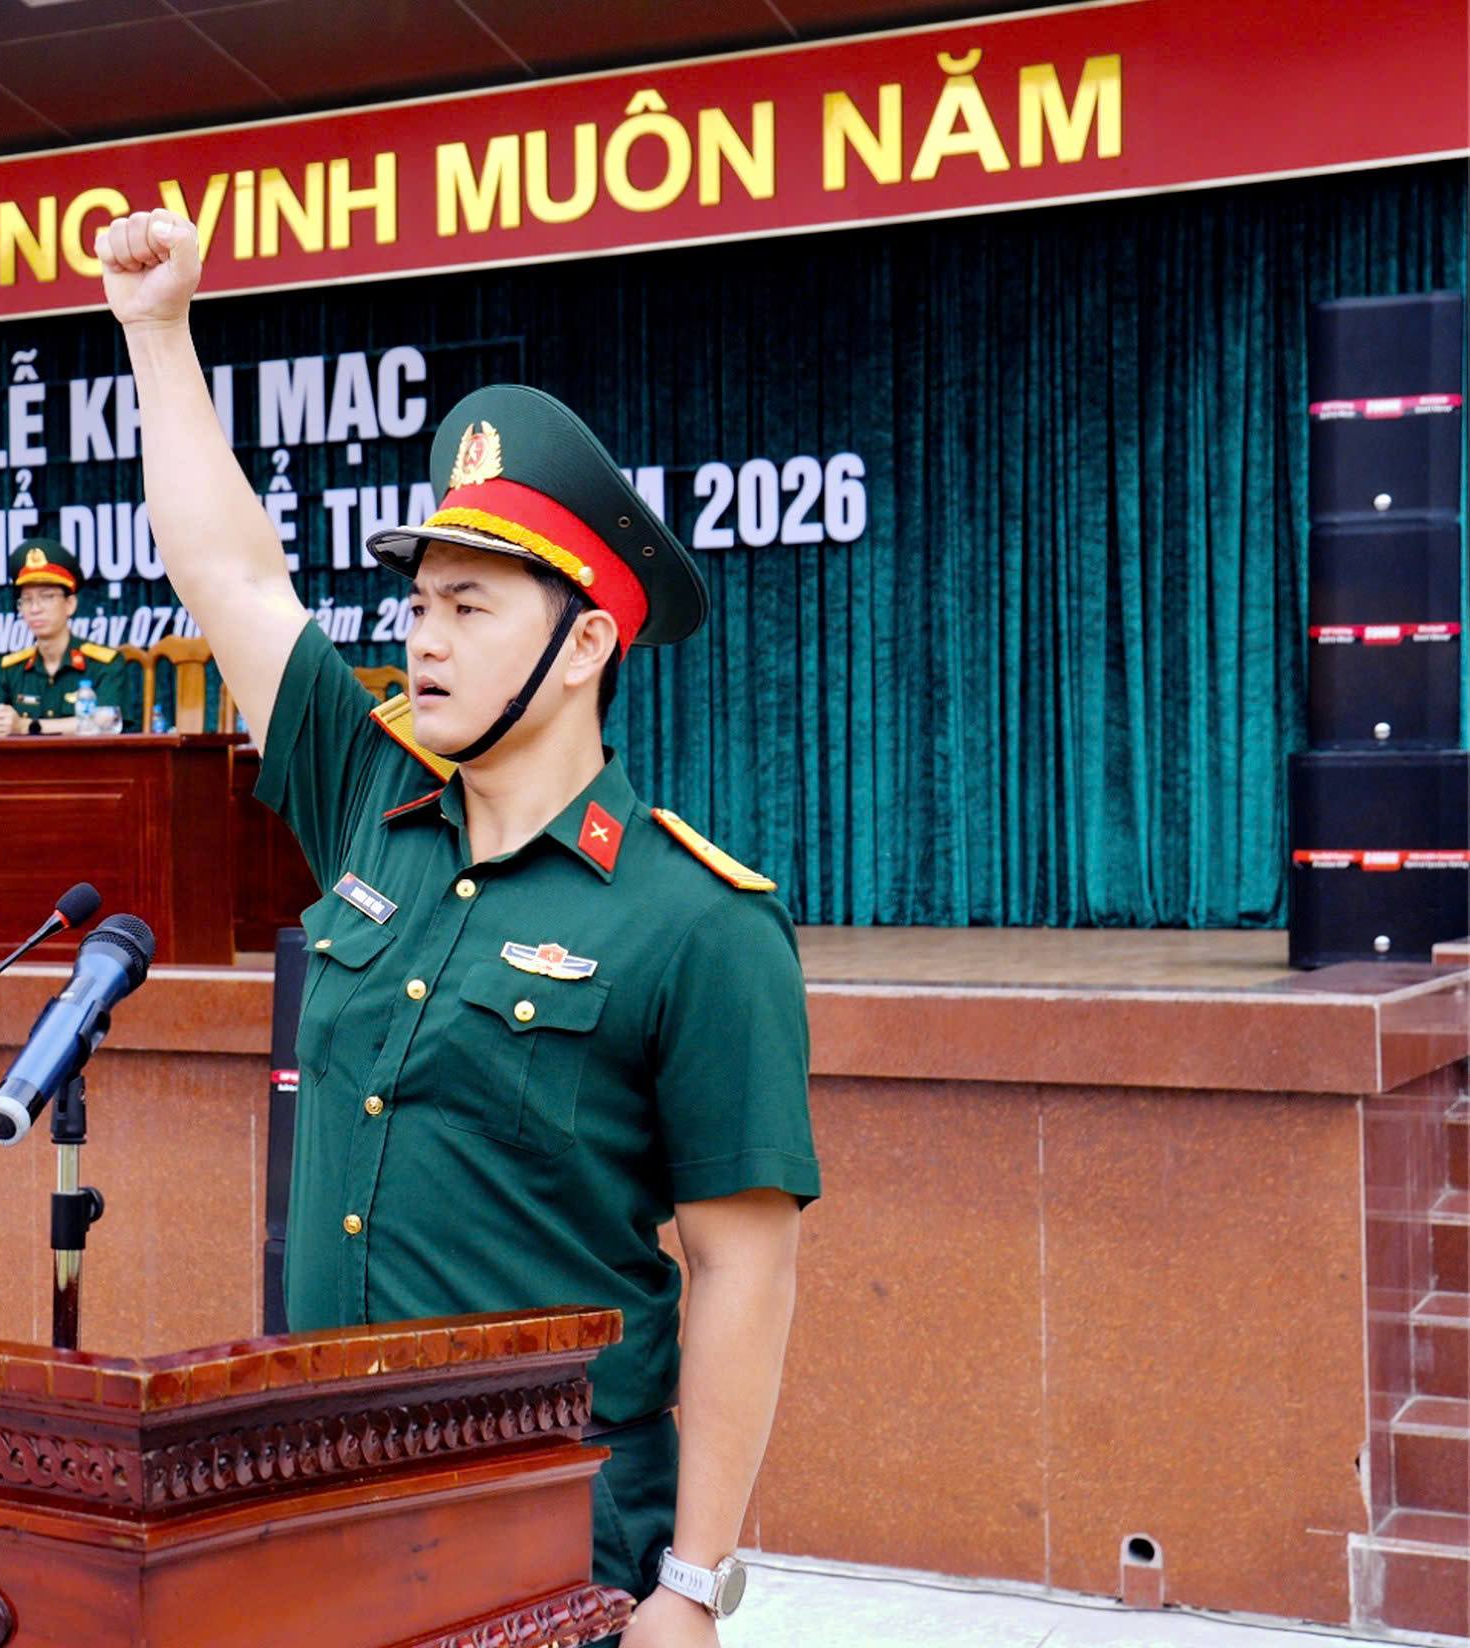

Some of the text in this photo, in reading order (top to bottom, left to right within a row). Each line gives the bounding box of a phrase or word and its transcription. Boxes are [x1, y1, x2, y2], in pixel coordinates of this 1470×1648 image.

[436, 89, 775, 237] MUÔN
[822, 48, 1122, 192] NĂM
[70, 365, 234, 463] KHI
[259, 346, 427, 465] MẠC
[692, 452, 867, 549] 2026
[133, 606, 173, 650] 07
[305, 597, 364, 643] ăm
[371, 597, 415, 642] 20
